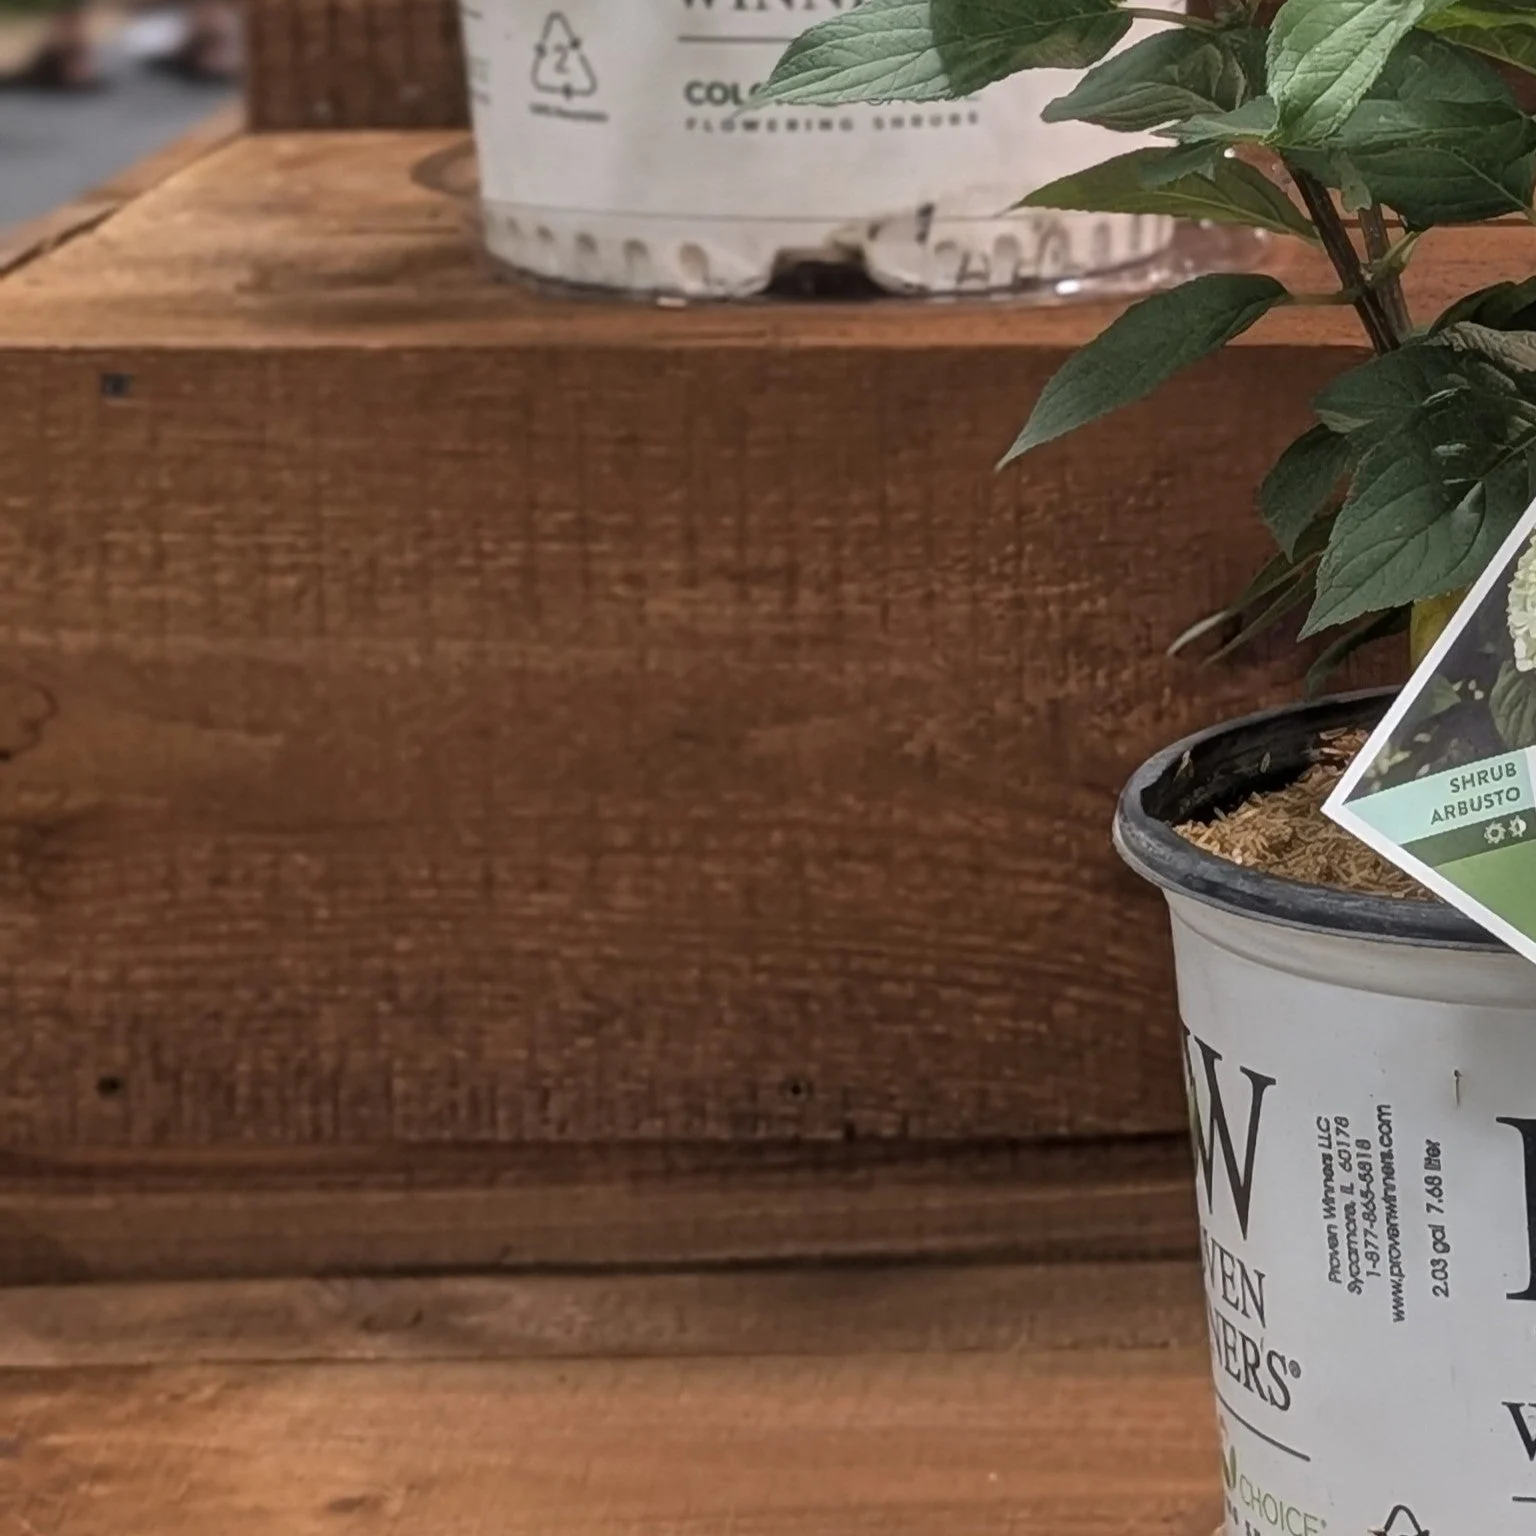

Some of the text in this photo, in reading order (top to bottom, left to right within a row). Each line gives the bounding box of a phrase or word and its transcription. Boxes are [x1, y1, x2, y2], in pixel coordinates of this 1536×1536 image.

[684, 80, 763, 107] COL
[1430, 786, 1521, 825] ARBUSTO
[1449, 762, 1518, 794] SHRUB
[1333, 1115, 1353, 1173] 60178
[1316, 1115, 1343, 1284] Proven Winners LLC
[1376, 1103, 1406, 1323] www.provenwinners.com
[1424, 1138, 1451, 1298] 2.03 gal 7.68 liter
